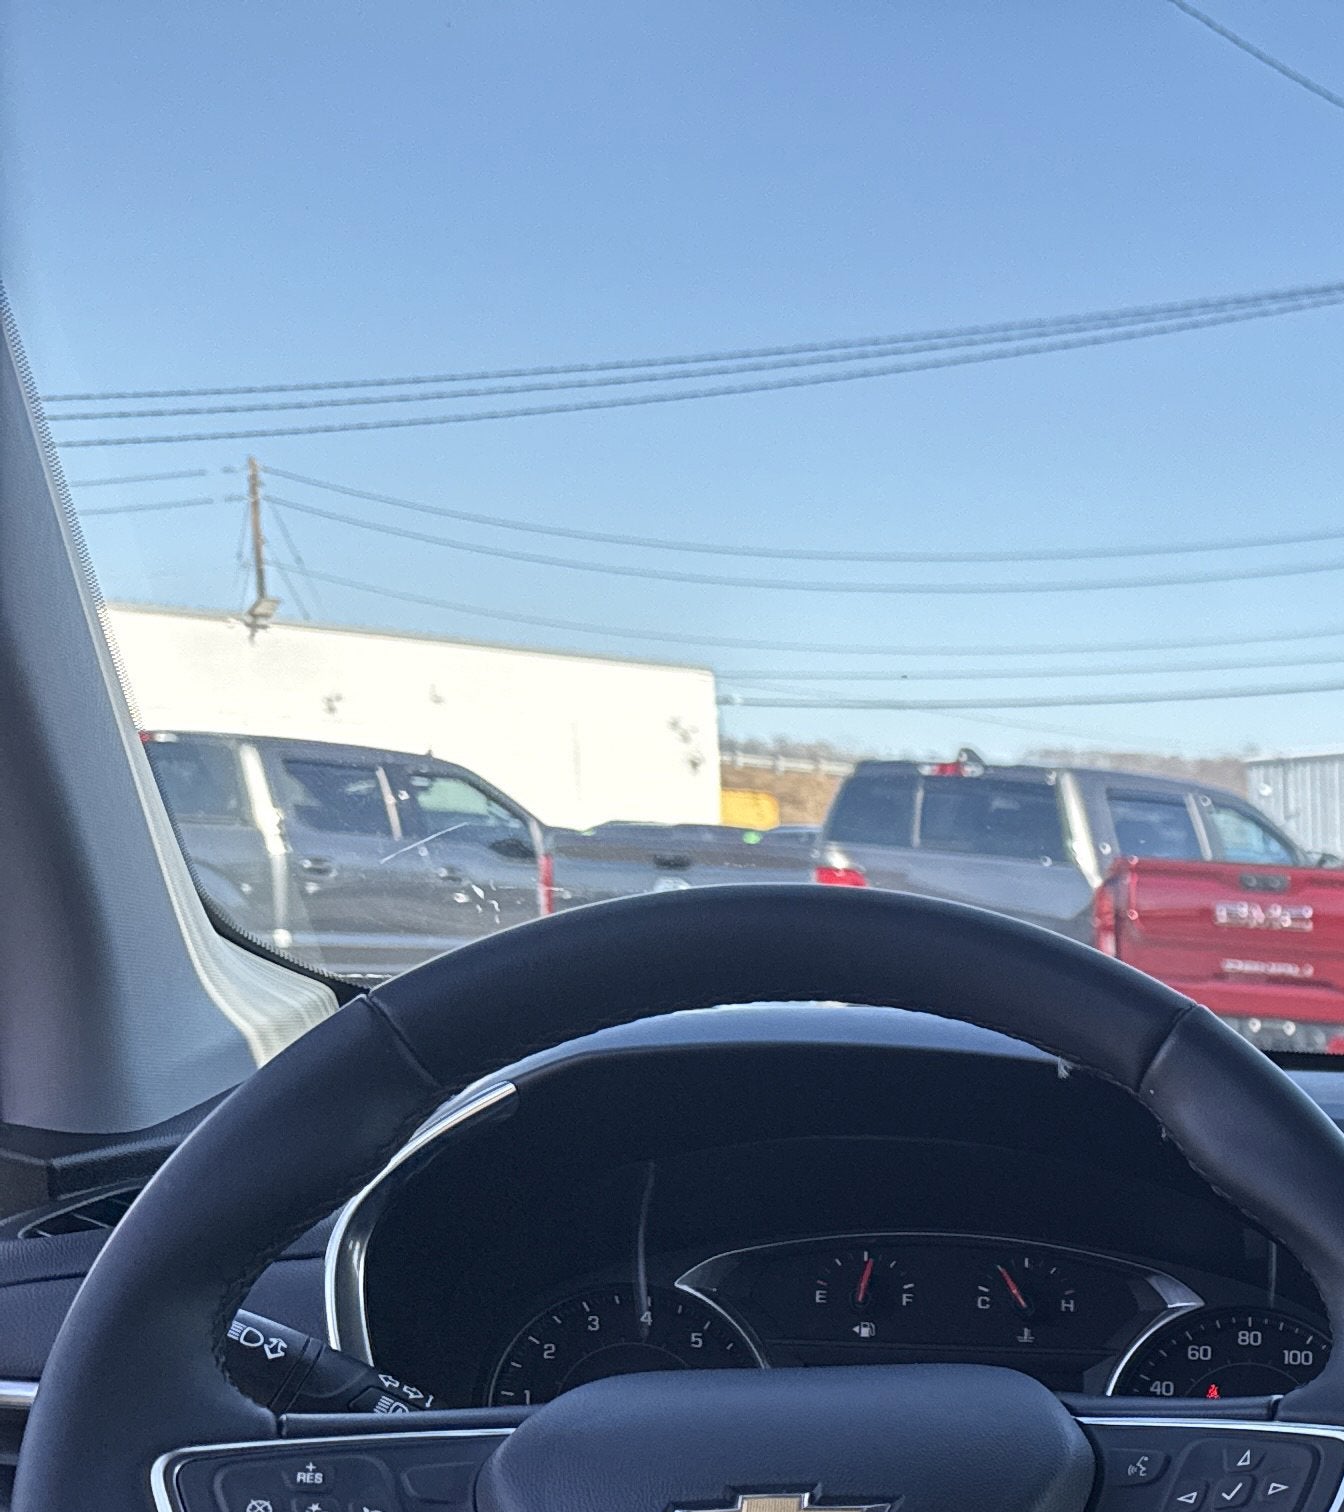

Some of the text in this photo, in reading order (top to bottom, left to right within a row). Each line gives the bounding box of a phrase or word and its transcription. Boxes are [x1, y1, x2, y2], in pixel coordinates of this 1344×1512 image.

[815, 1289, 828, 1303] E
[902, 1293, 914, 1306] F
[977, 1296, 990, 1309] C
[1061, 1299, 1075, 1312] H
[587, 1315, 600, 1331] 3
[640, 1311, 653, 1326] 4
[690, 1332, 703, 1348] 5
[1237, 1330, 1262, 1346] 80
[543, 1343, 556, 1359] 2
[1187, 1345, 1212, 1361] 60
[1283, 1349, 1313, 1366] 100
[1150, 1380, 1175, 1397] 40
[296, 1472, 323, 1484] RES
